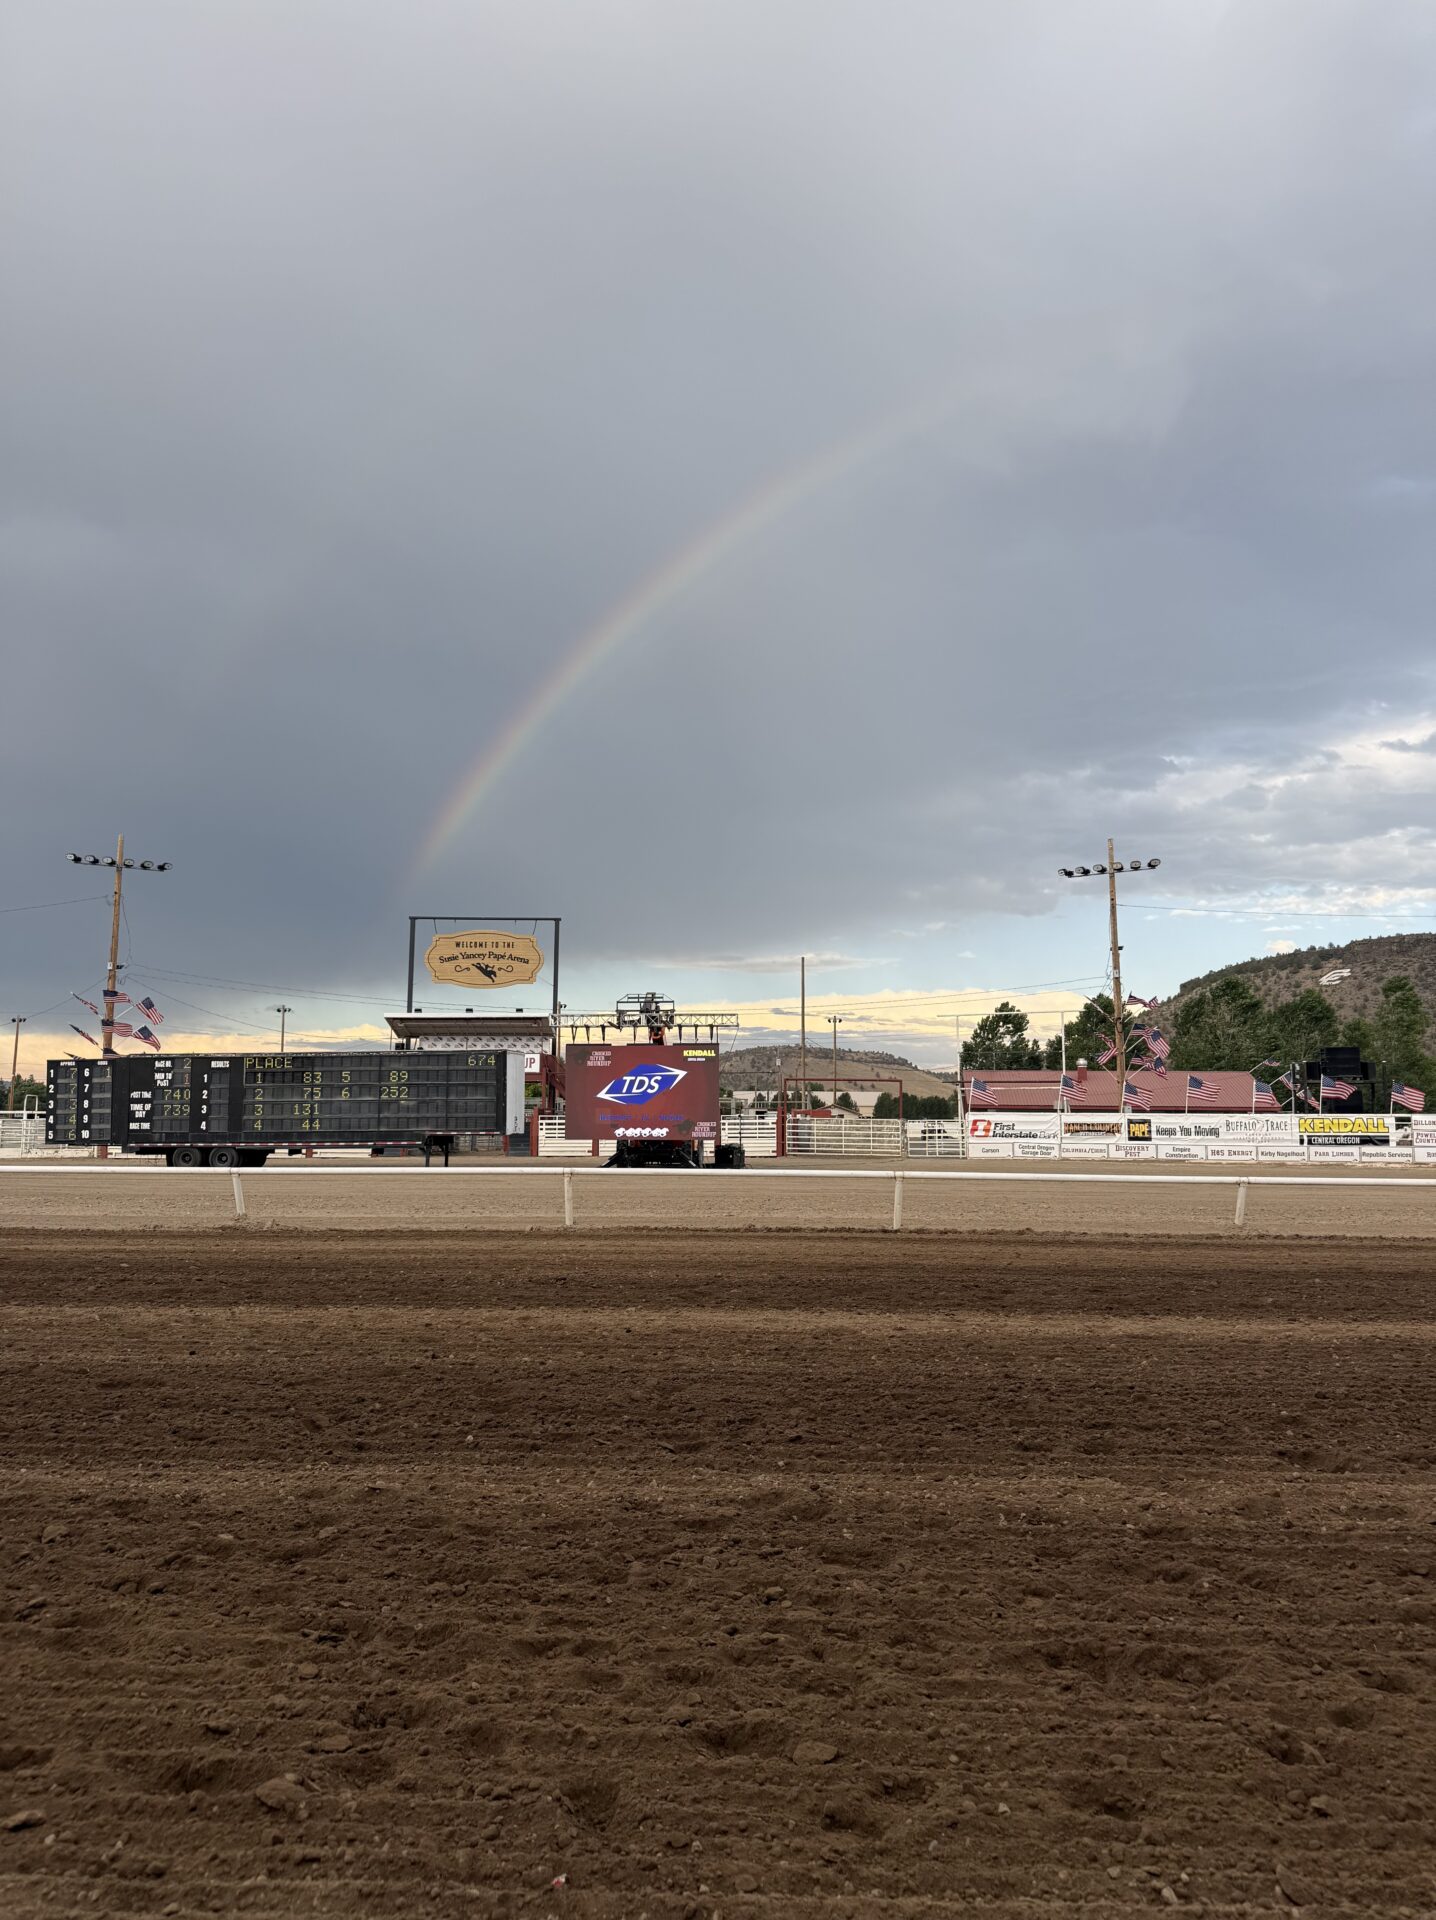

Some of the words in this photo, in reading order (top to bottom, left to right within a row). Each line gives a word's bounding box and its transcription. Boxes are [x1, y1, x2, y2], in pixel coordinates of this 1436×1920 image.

[455, 941, 488, 949] WELCOME
[491, 941, 499, 949] TO
[503, 941, 515, 949] THE
[439, 953, 459, 964] Susie
[460, 951, 487, 960] Yancey
[488, 951, 506, 961] Papé
[507, 953, 530, 964] Arena
[683, 1049, 716, 1057] KENDALL
[155, 1060, 166, 1068] RACE
[183, 1058, 191, 1069] 2
[211, 1060, 230, 1068] RESULTS
[246, 1057, 293, 1069] PLACE
[468, 1054, 496, 1066] 674
[50, 1069, 54, 1078] 1
[70, 1067, 77, 1079] 7
[84, 1068, 90, 1077] 6
[106, 1067, 111, 1078] 1
[203, 1074, 208, 1083] 1
[256, 1073, 263, 1084] 1
[303, 1072, 322, 1083] 83
[342, 1072, 350, 1083] 5
[390, 1071, 408, 1082] 89
[184, 1073, 190, 1085] 1
[622, 1076, 662, 1093] TDS
[49, 1084, 54, 1093] 2
[70, 1084, 77, 1095] 7
[84, 1084, 89, 1093] 7
[164, 1089, 191, 1101] 740
[202, 1090, 208, 1099] 2
[255, 1089, 263, 1100] 2
[303, 1088, 322, 1099] 75
[341, 1087, 350, 1099] 6
[381, 1087, 408, 1098] 252
[48, 1100, 54, 1109] 3
[70, 1099, 77, 1110] 3
[83, 1099, 89, 1108] 8
[144, 1103, 152, 1111] OF
[164, 1105, 190, 1116] 739
[201, 1105, 207, 1114] 3
[254, 1105, 263, 1116] 3
[293, 1104, 320, 1115] 131
[48, 1115, 54, 1124] 4
[68, 1114, 77, 1125] 4
[83, 1115, 88, 1123] 9
[254, 1119, 262, 1131] 4
[302, 1119, 320, 1131] 44
[200, 1121, 206, 1130] 4
[993, 1122, 1015, 1130] First
[1225, 1119, 1257, 1132] BUFFALO
[1265, 1119, 1288, 1132] TRACE
[1298, 1118, 1390, 1133] KENDALL
[48, 1130, 54, 1139] 5
[68, 1129, 77, 1140] 6
[81, 1130, 89, 1139] 10
[1039, 1131, 1059, 1139] Bank
[1156, 1125, 1177, 1138] Keeps
[1179, 1125, 1192, 1136] You
[1194, 1125, 1220, 1138] Moving
[1311, 1136, 1335, 1144] CENTRAL
[1336, 1136, 1360, 1144] OREGON
